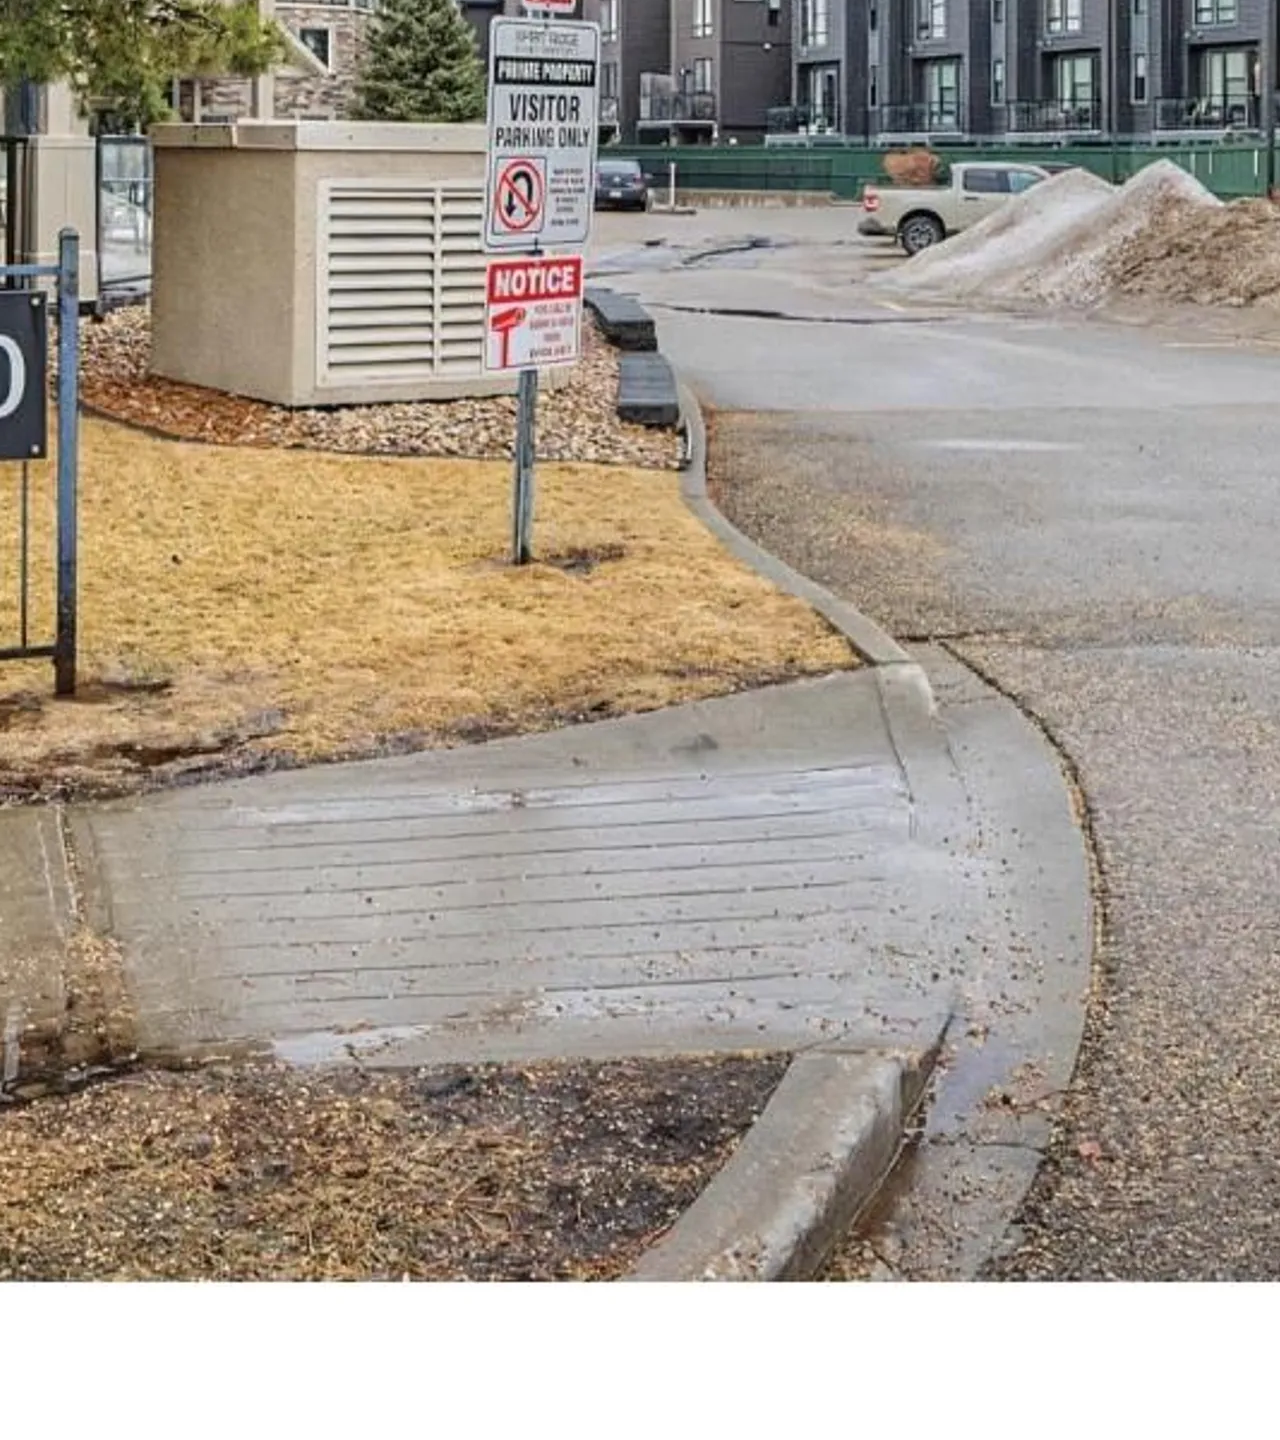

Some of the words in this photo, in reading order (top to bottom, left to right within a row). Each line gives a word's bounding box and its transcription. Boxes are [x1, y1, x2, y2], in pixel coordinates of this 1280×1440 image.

[497, 60, 541, 80] PRIVATE
[541, 62, 593, 83] PROPERTY
[509, 93, 581, 122] VISITOR
[495, 126, 555, 148] PARKING
[558, 127, 590, 148] ONLY
[493, 266, 576, 298] NOTICE
